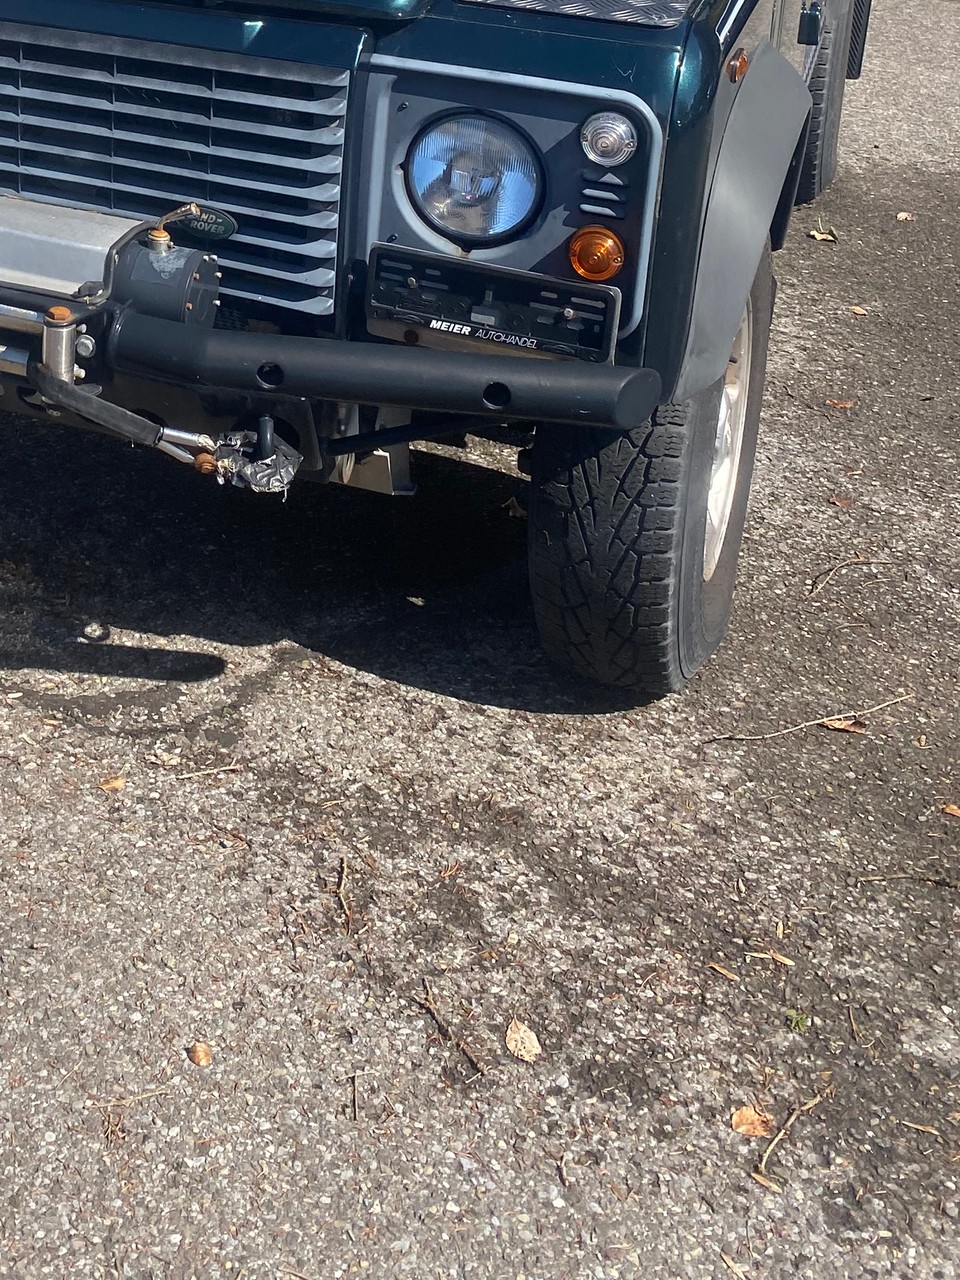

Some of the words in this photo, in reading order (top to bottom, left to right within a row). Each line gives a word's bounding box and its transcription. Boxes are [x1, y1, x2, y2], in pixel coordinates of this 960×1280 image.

[190, 221, 225, 234] ROVER
[429, 319, 471, 336] MEIER
[474, 329, 538, 349] AUTOHANDEL
